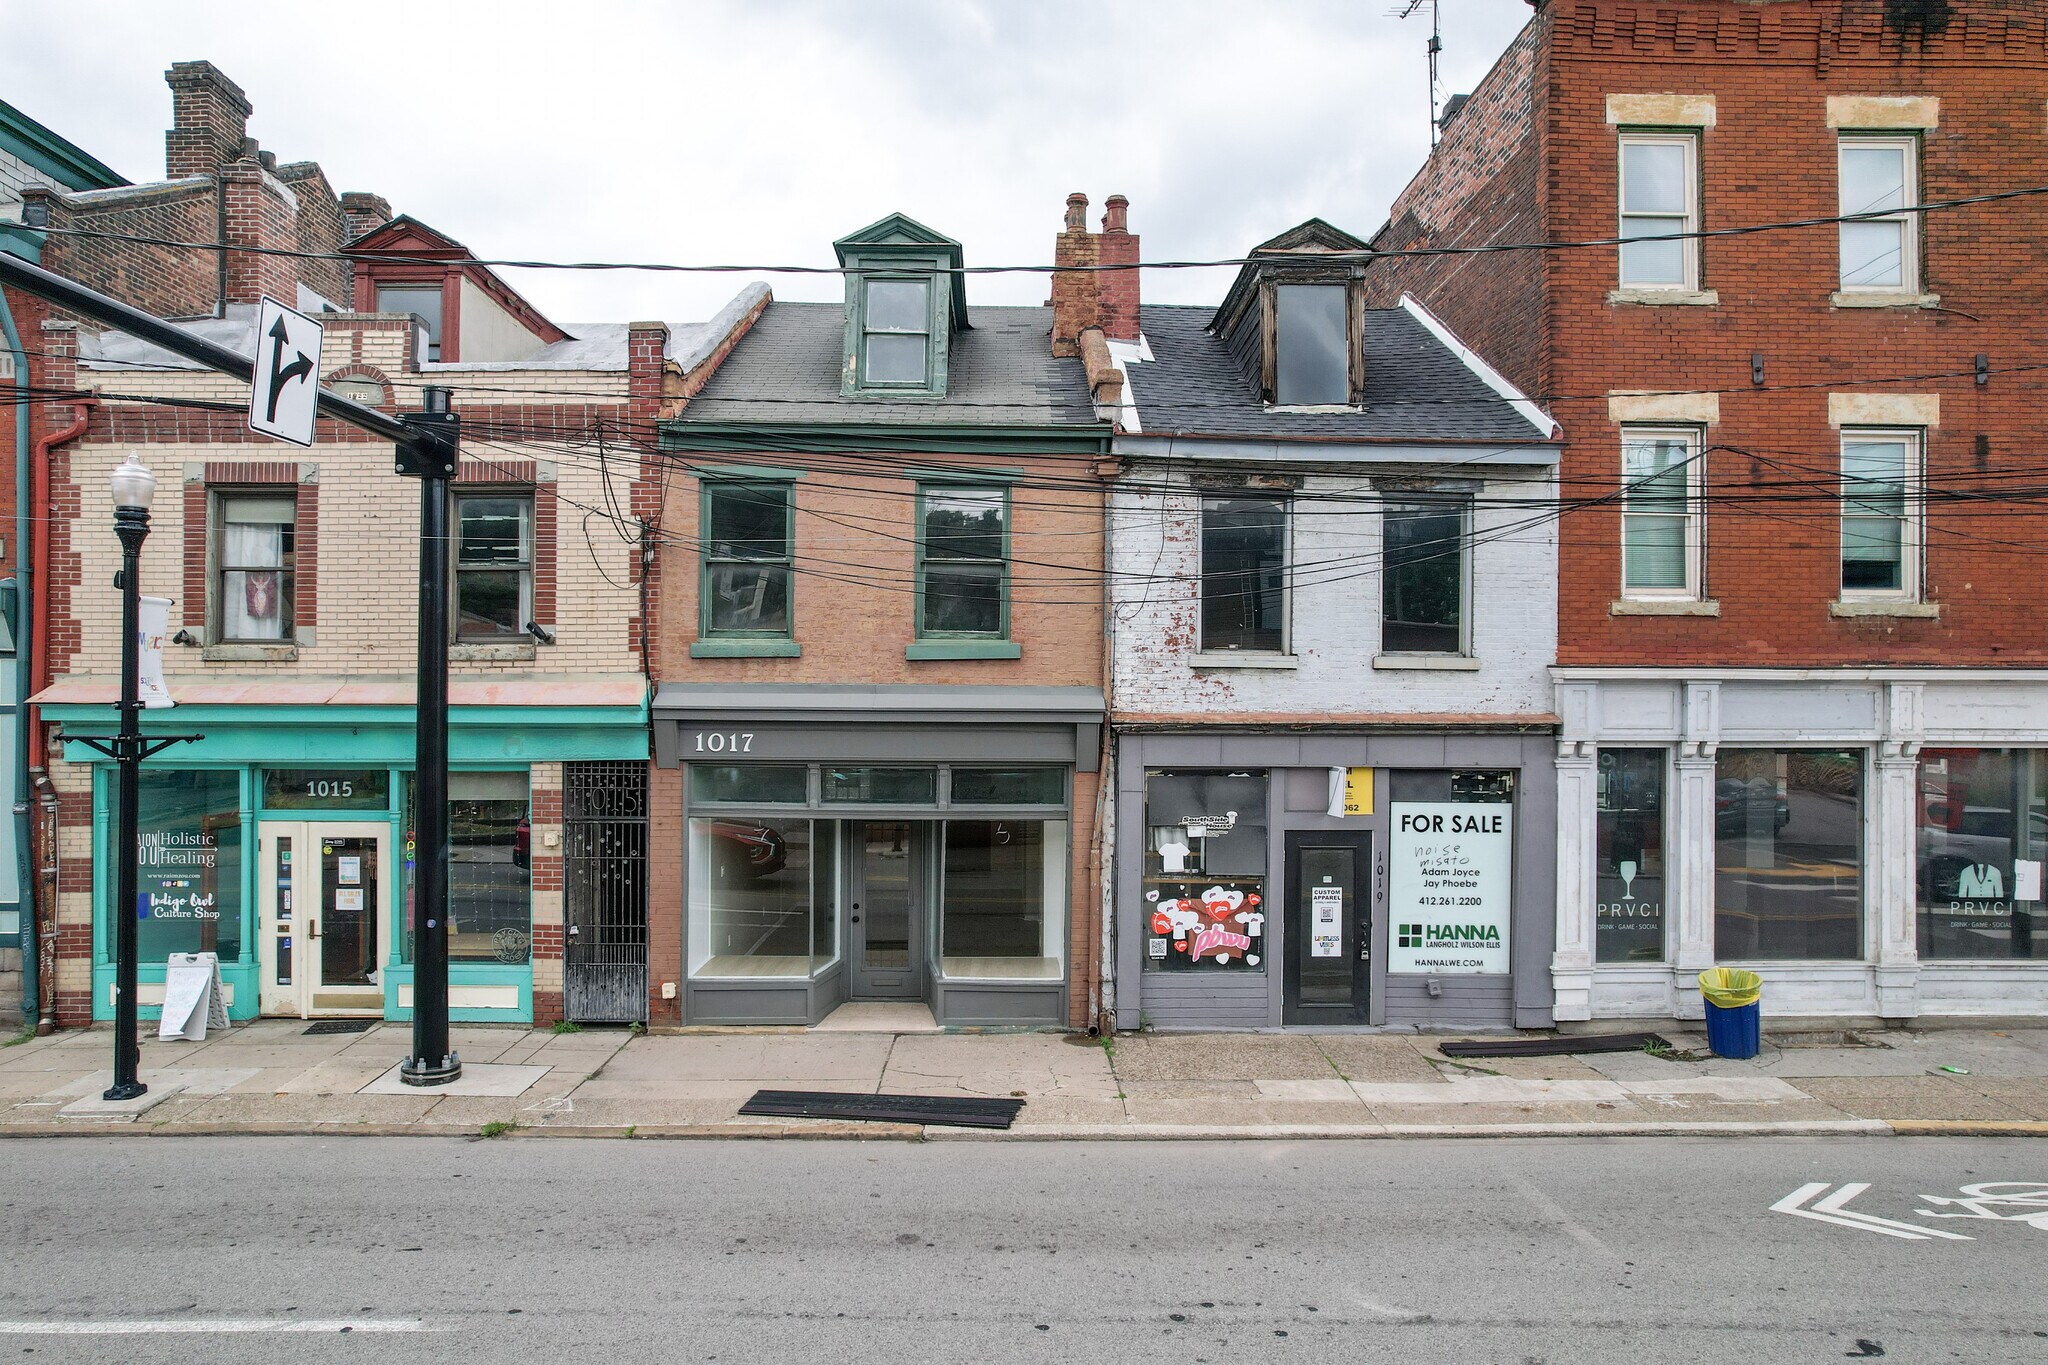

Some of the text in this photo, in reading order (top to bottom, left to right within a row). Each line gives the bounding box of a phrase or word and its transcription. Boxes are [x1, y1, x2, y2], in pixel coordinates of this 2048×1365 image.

[695, 732, 754, 752] 1017
[306, 780, 353, 798] 1015
[1401, 814, 1502, 834] FOR SALE
[137, 833, 158, 847] AION
[160, 832, 215, 846] Holistic
[160, 851, 216, 868] Healing
[1376, 850, 1384, 904] 1019
[1421, 868, 1481, 878] Adam Joyce
[1423, 879, 1478, 889] Jay Phoebe
[150, 892, 214, 912] Indigo Owl
[1419, 897, 1482, 906] 412.261.2200
[1950, 901, 2013, 916] PRVCI
[154, 906, 220, 919] Culture Shop
[1597, 903, 1659, 917] PRVCI
[1426, 925, 1500, 940] HANNA
[1426, 941, 1500, 949] LANGHOLZ WILSON ELLIS
[1415, 959, 1484, 967] HANNALWE.COM
